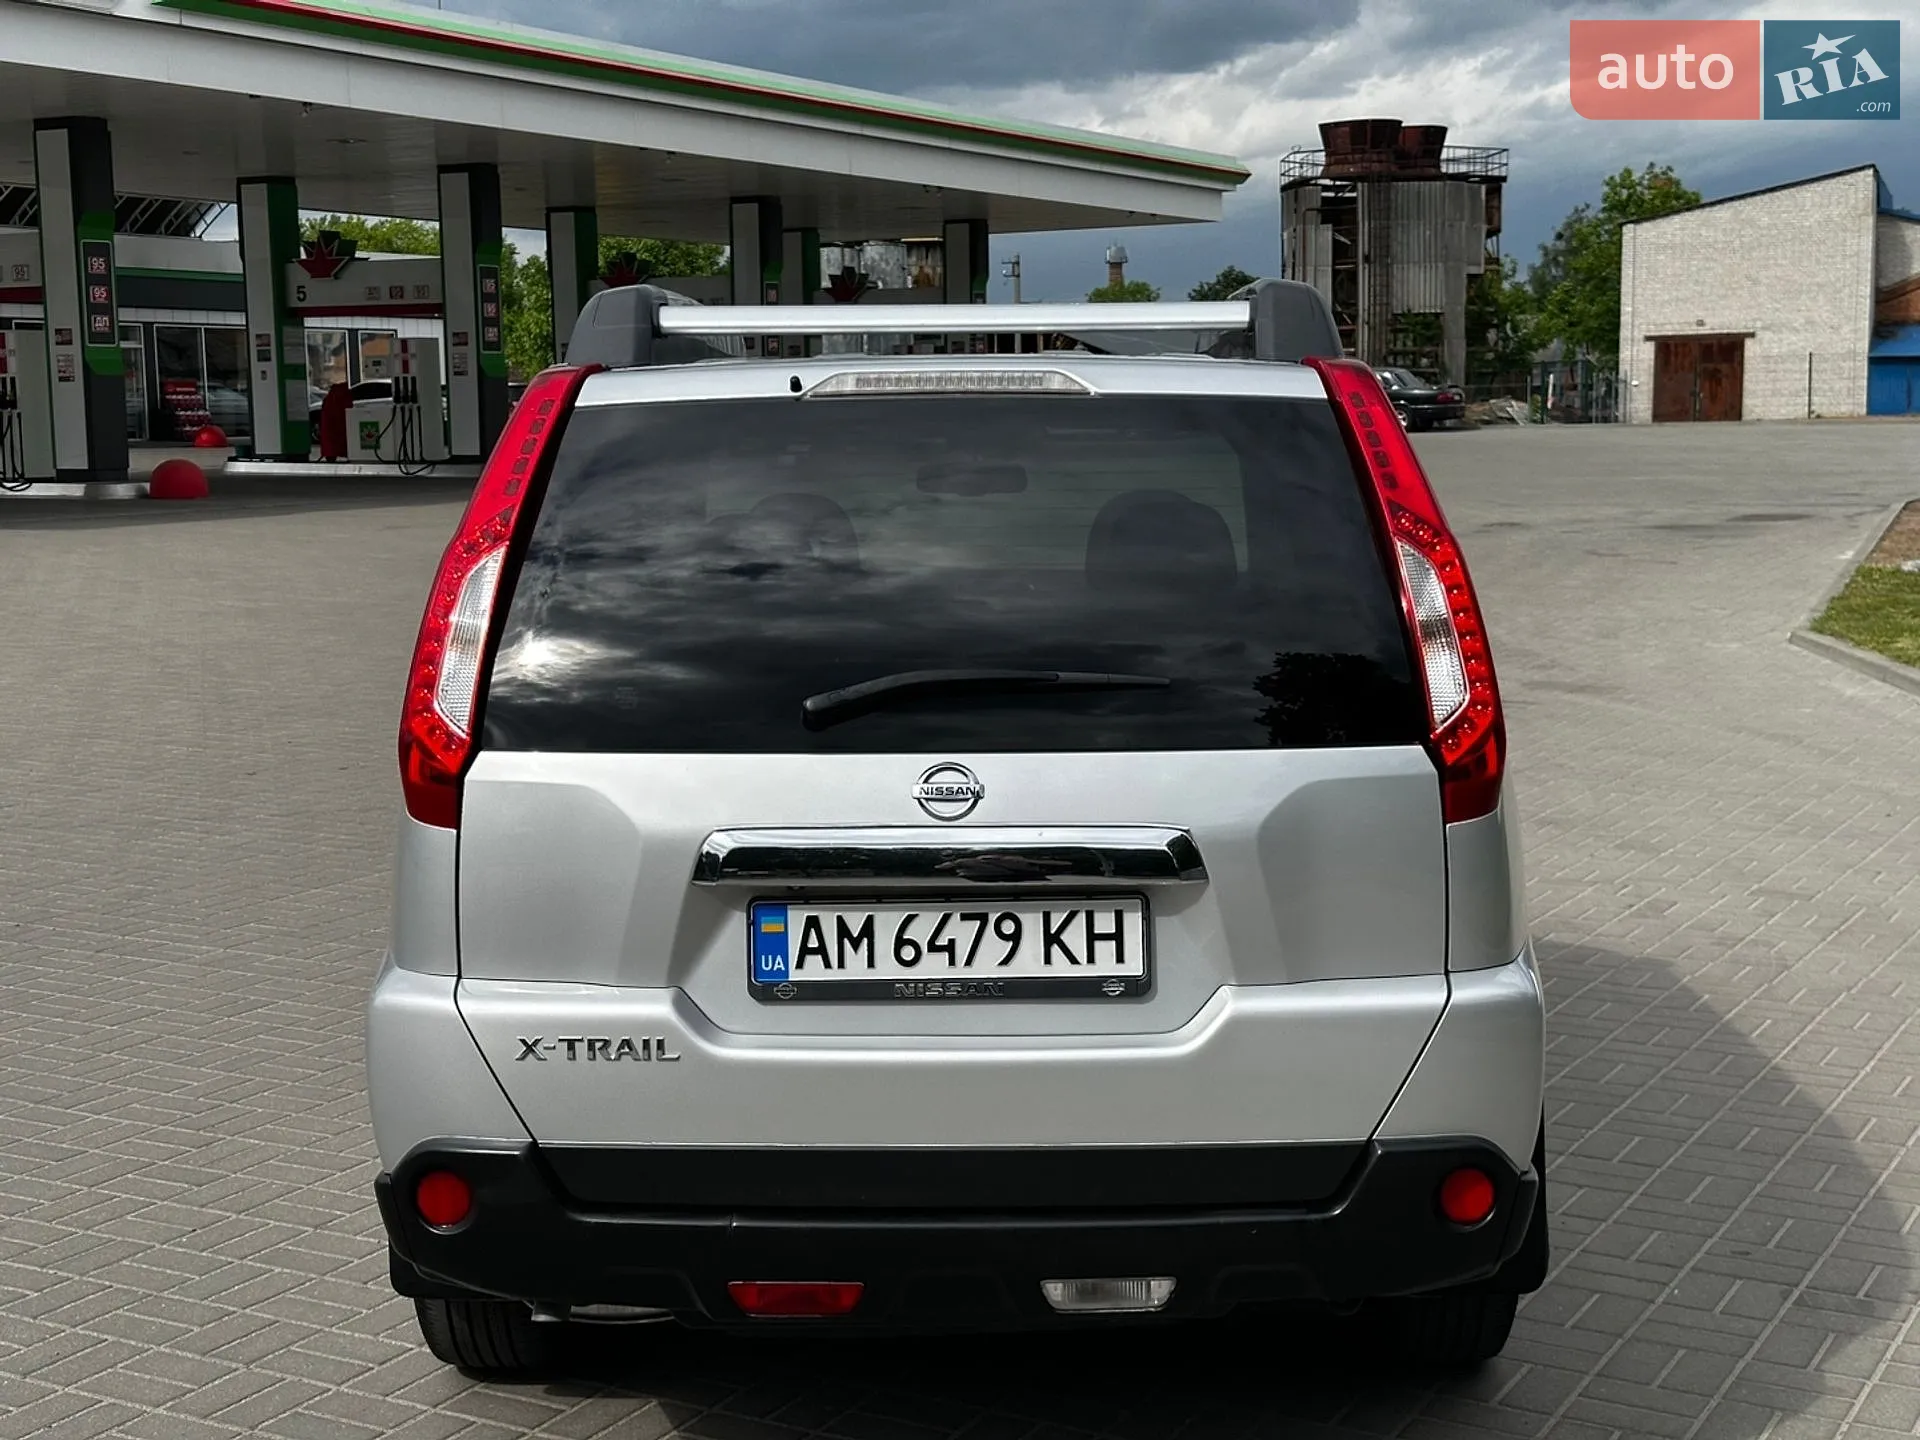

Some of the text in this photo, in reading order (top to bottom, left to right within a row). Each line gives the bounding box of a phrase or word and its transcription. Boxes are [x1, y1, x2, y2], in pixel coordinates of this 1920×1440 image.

[296, 285, 307, 302] 5
[919, 786, 976, 796] NISSAN
[794, 909, 1125, 970] AM 6479 KH
[761, 955, 785, 972] UA
[894, 982, 1004, 997] NISSAN
[514, 1035, 681, 1062] X-TRAIL
